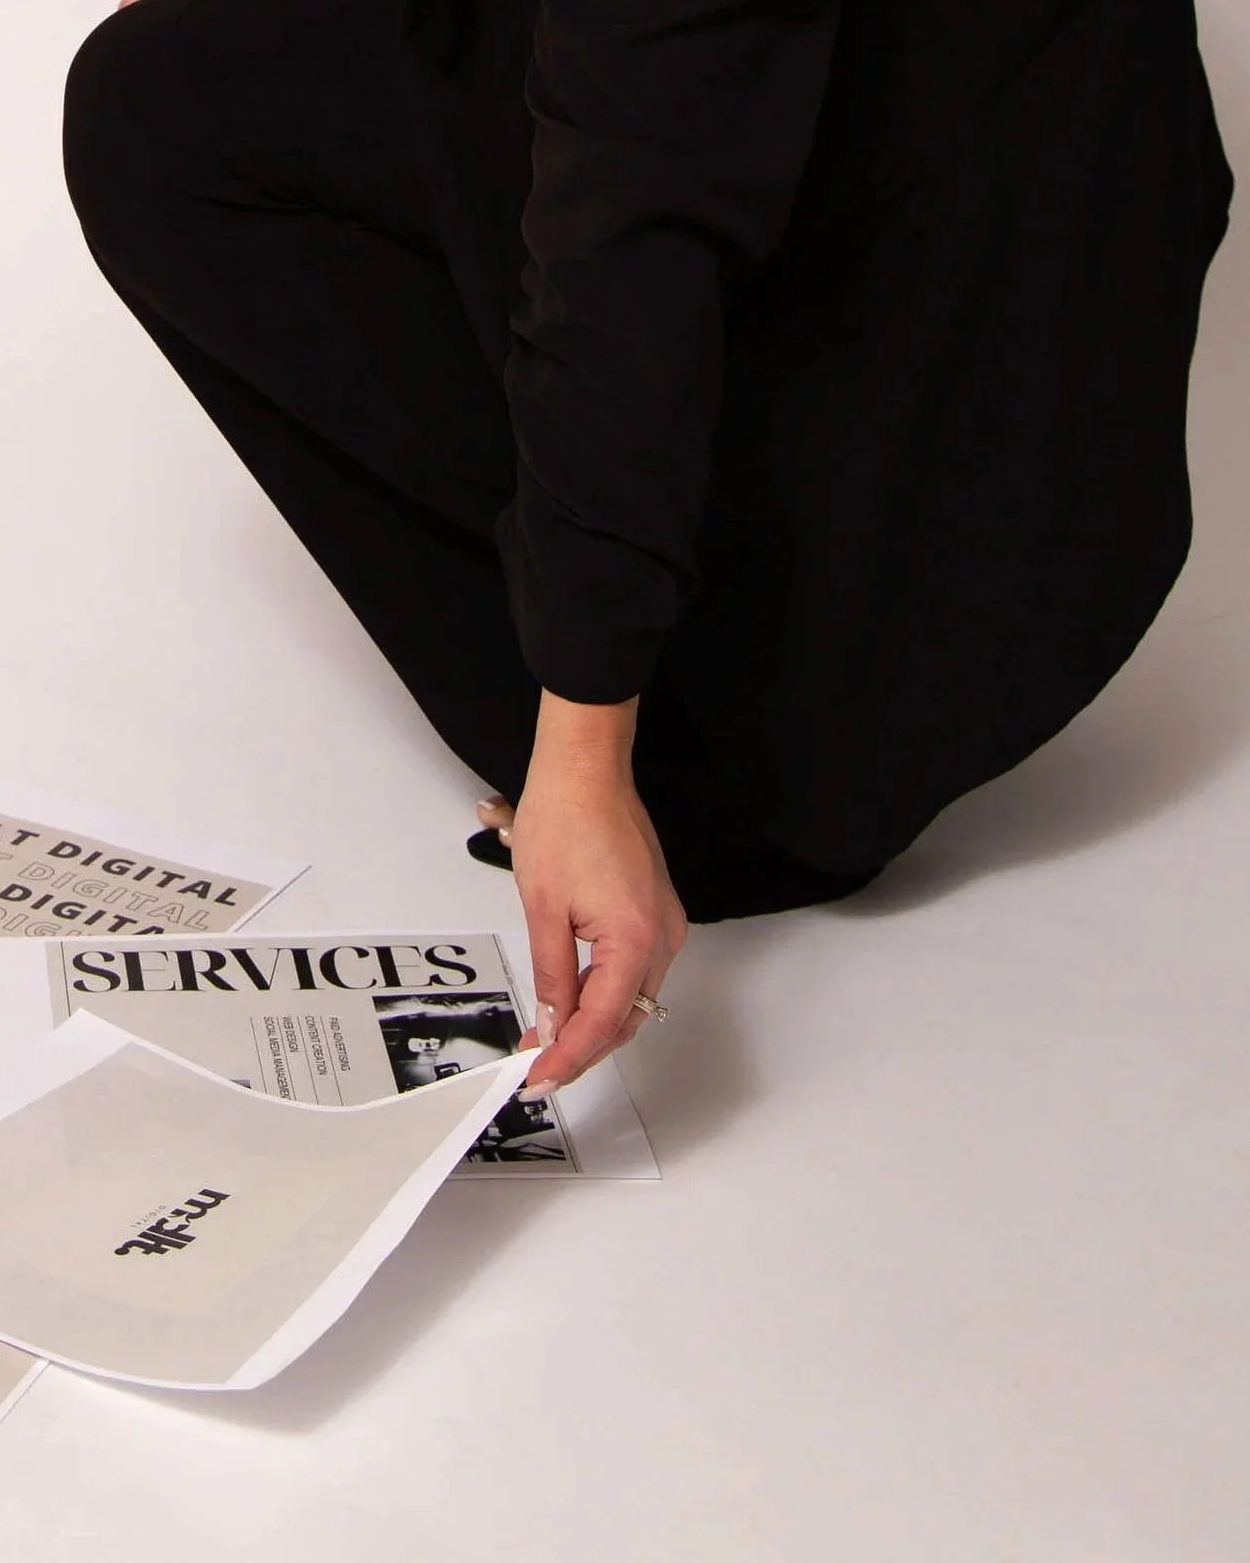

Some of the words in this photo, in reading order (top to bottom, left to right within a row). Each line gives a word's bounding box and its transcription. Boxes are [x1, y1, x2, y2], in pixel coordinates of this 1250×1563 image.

[47, 840, 237, 907] DIGITAL
[17, 861, 210, 931] DIGITAL
[72, 944, 477, 993] SERVICES
[263, 1016, 276, 1037] SOCIAL
[283, 1029, 299, 1053] DESIGN
[305, 1015, 320, 1043] CONTENT
[269, 1038, 281, 1057] MEDIA
[312, 1043, 328, 1076] CREATION
[333, 1032, 351, 1072] ADVERTISING
[273, 1058, 291, 1100] MANAGEMEN
